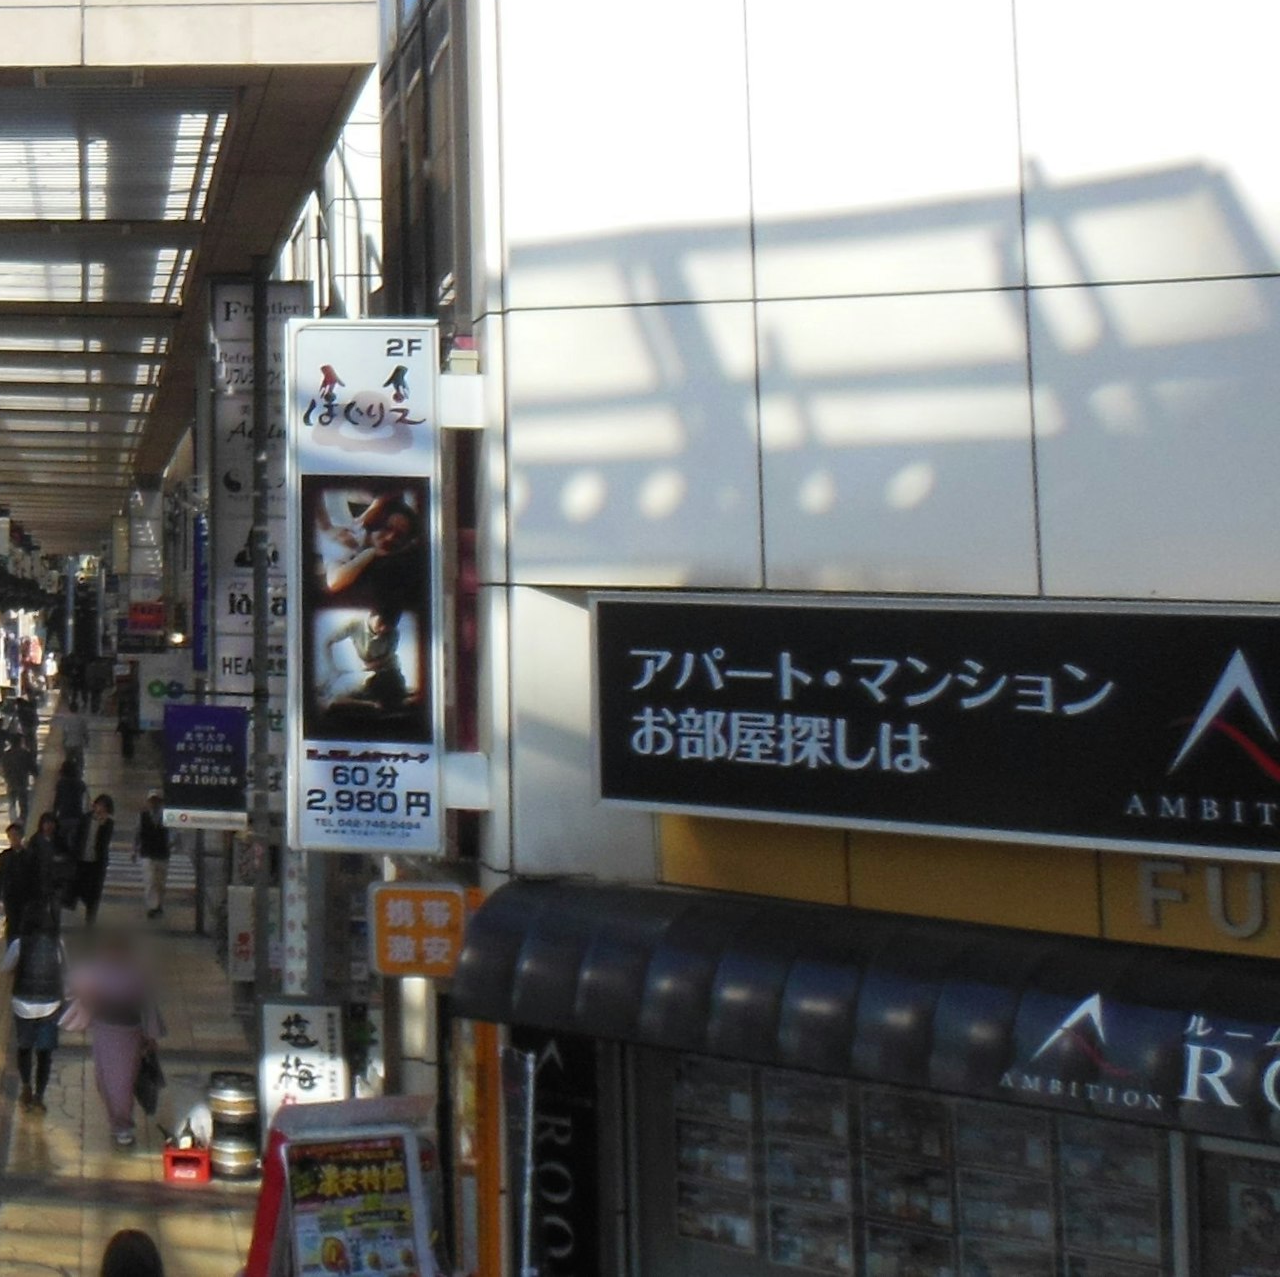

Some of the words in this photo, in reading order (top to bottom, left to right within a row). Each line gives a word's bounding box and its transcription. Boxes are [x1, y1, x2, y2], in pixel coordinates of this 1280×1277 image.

[386, 338, 422, 357] 2F
[630, 647, 1114, 715] アパート・マンション
[631, 706, 930, 773] お部屋探しは
[332, 765, 399, 789] 60分
[307, 788, 431, 817] 2,980円
[1000, 1072, 1162, 1111] AMBITION
